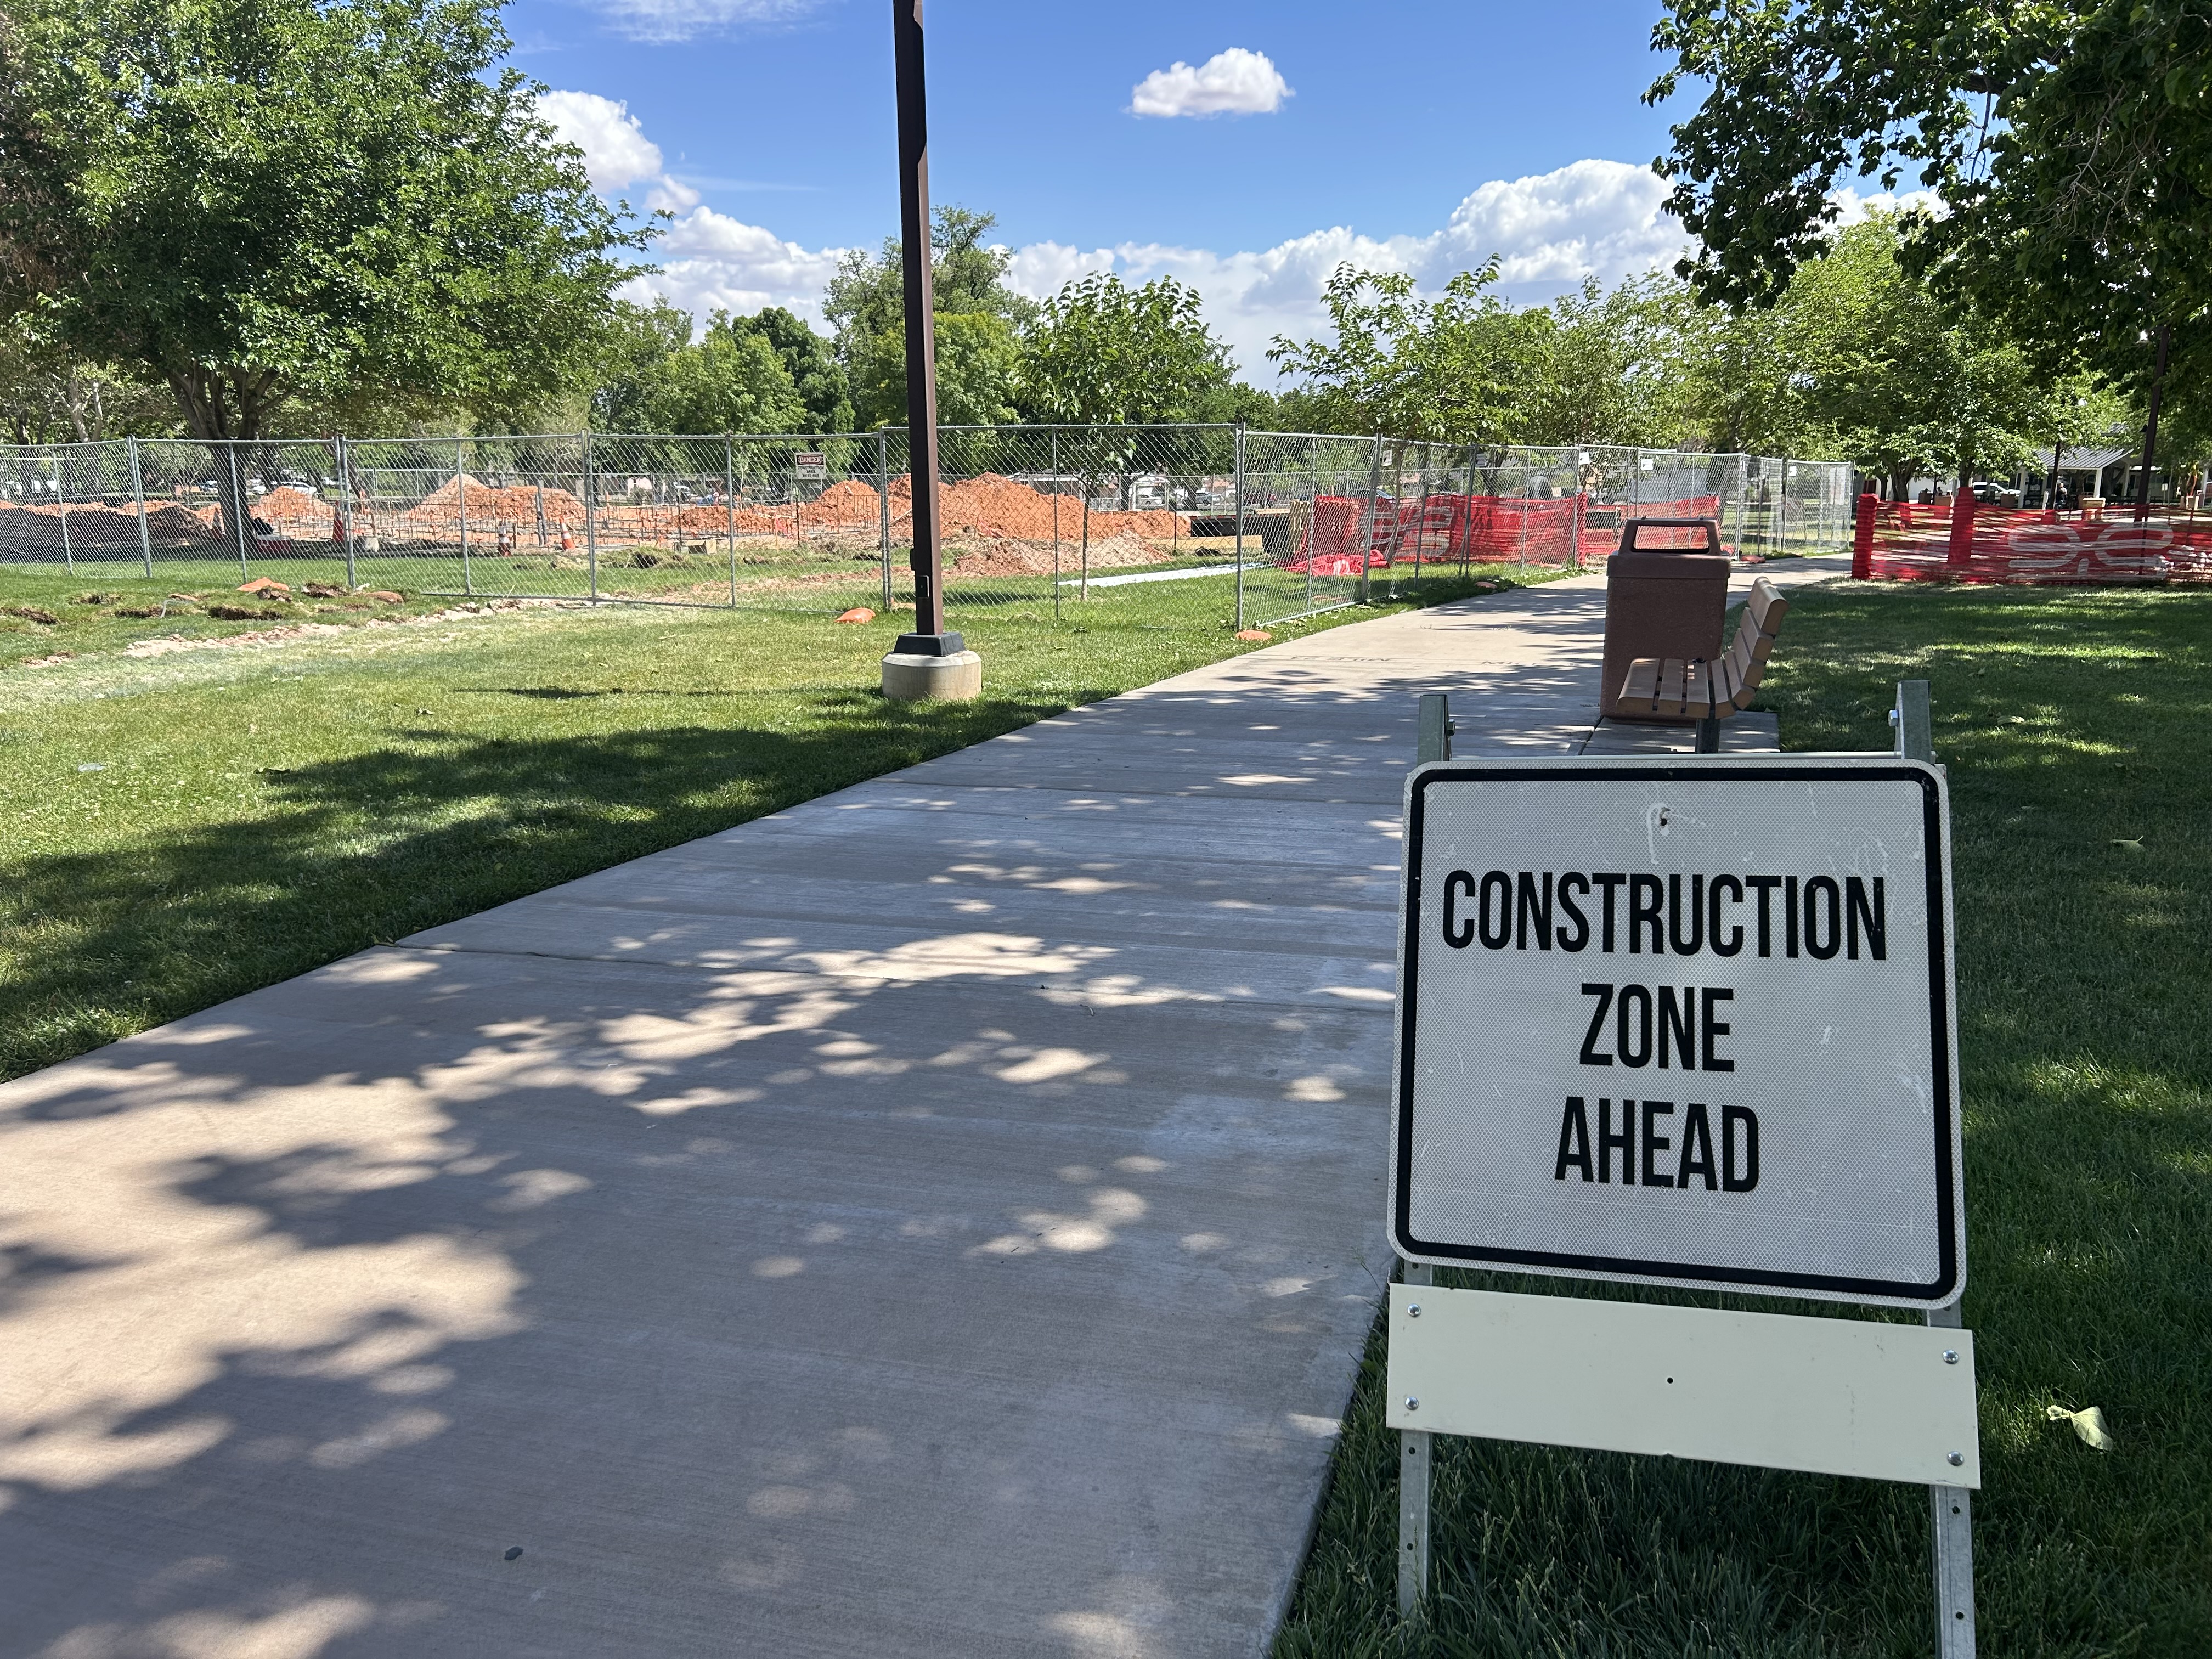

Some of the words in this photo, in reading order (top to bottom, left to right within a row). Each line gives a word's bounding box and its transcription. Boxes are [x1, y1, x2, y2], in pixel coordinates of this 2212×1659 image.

[1443, 870, 1886, 961] CONSTRUCTION
[1579, 983, 1735, 1073] ZONE
[1554, 1096, 1759, 1193] AHEAD
